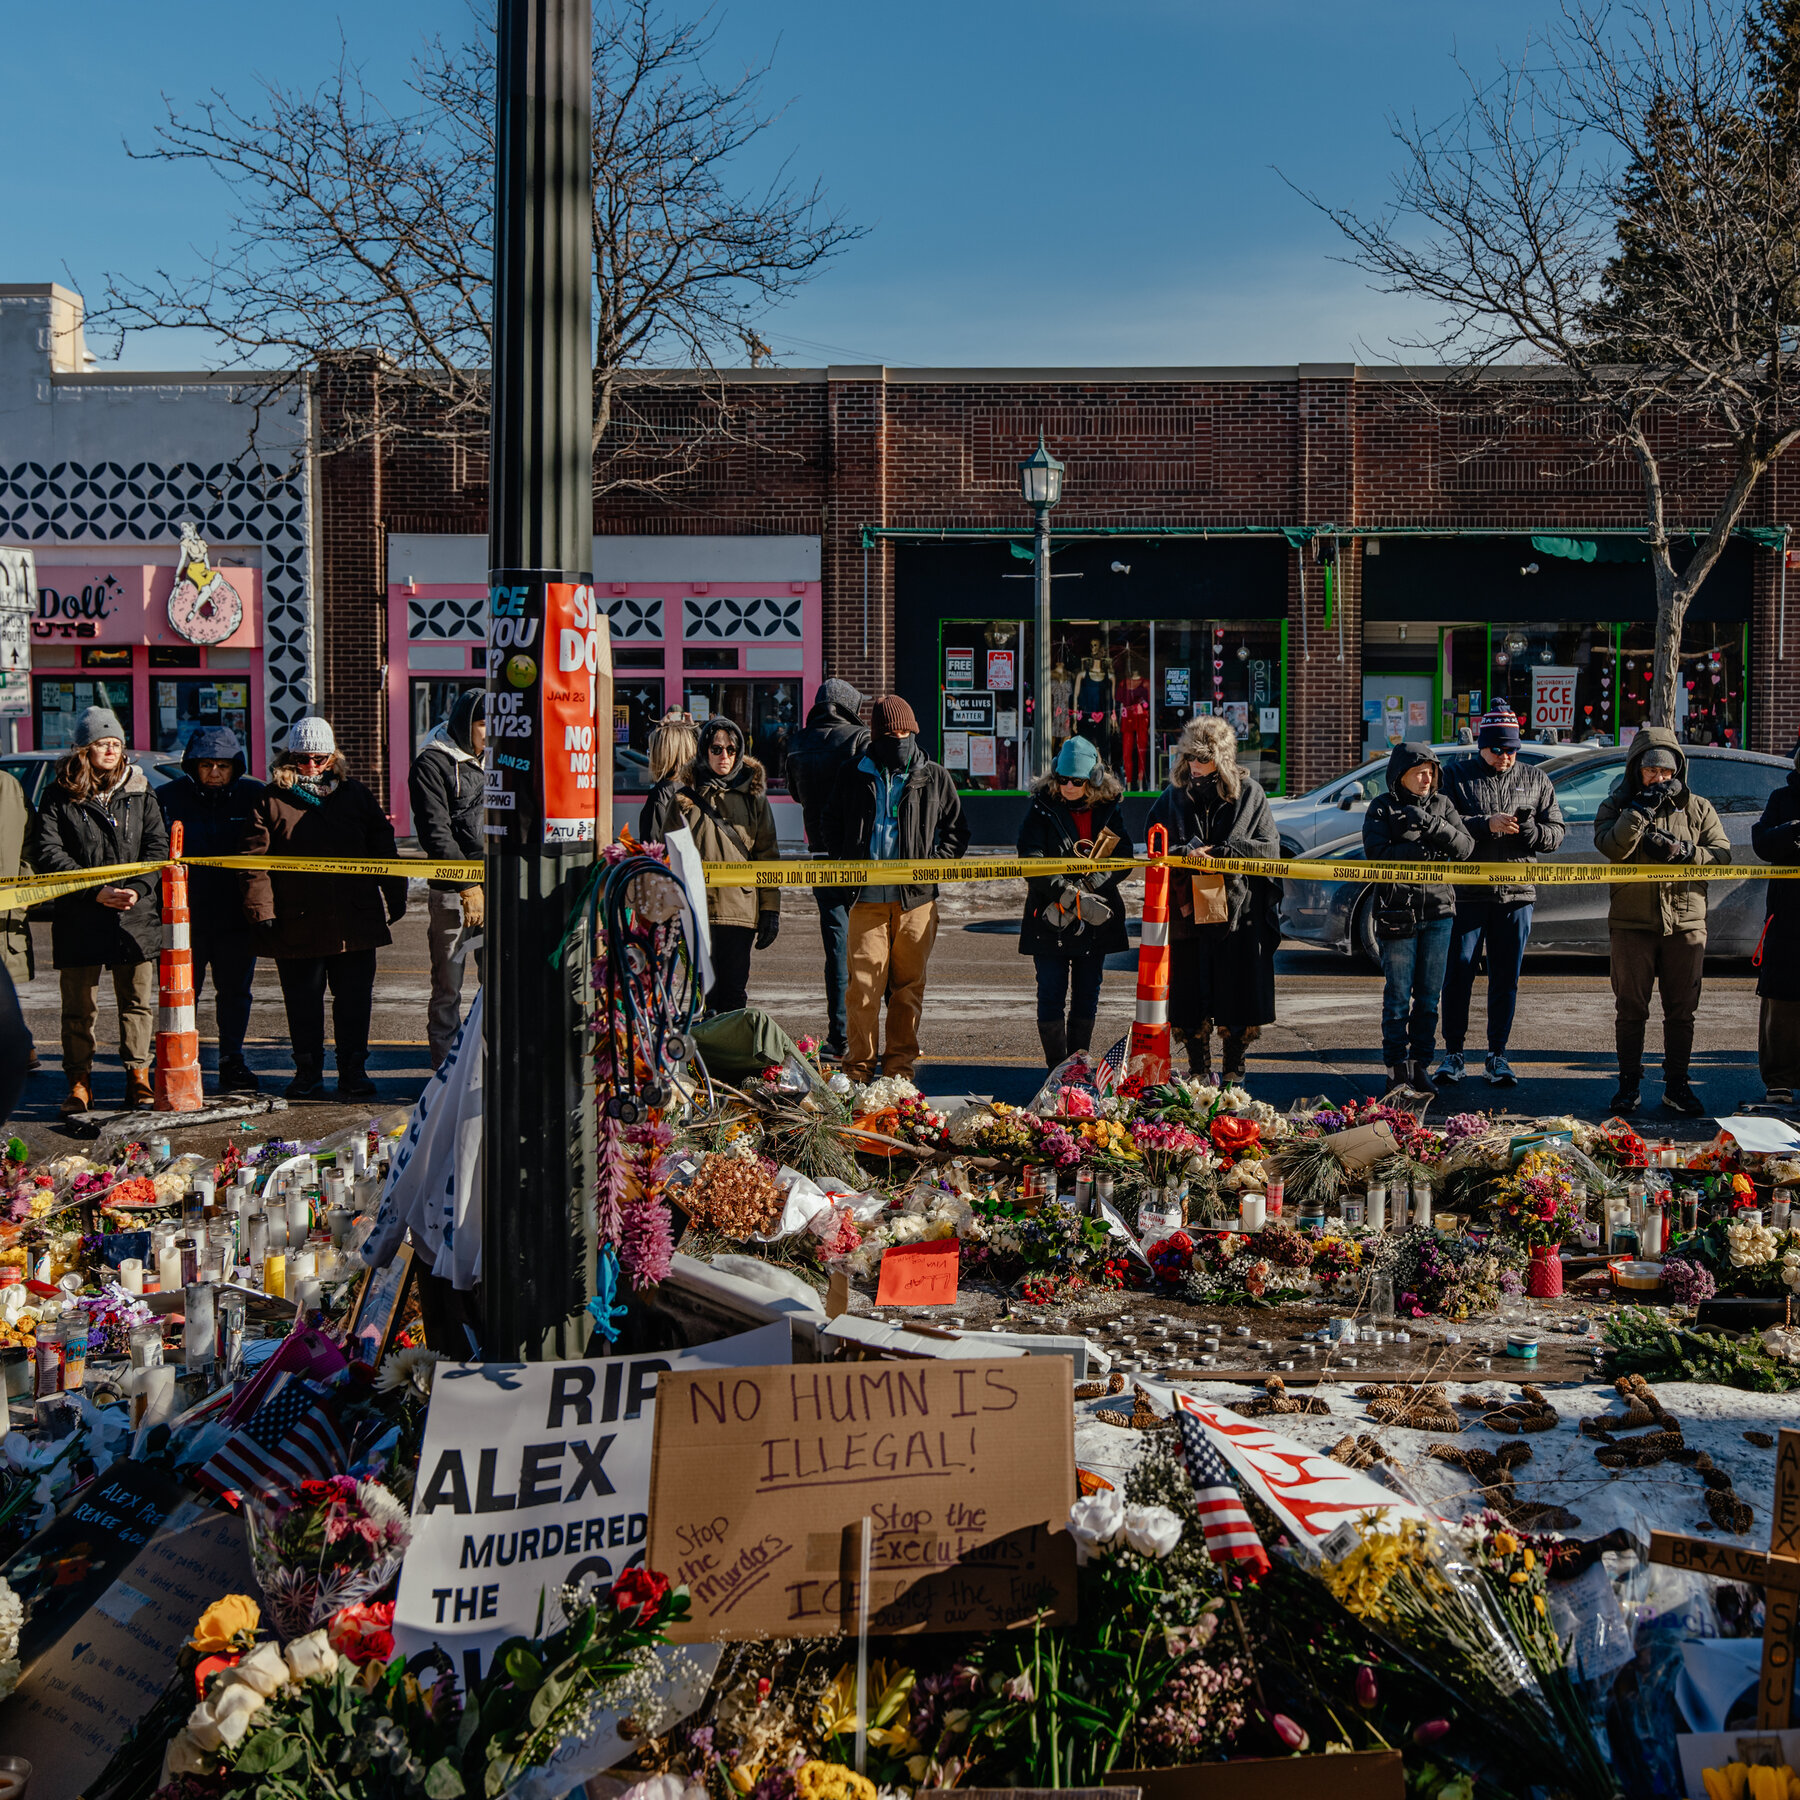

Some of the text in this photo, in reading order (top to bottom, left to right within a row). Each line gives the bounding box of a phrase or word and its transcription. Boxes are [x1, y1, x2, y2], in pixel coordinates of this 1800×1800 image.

[37, 585, 110, 620] Doll
[1, 630, 26, 643] ROUTE
[2, 617, 26, 627] TRUCK
[948, 661, 972, 671] FREE
[1253, 660, 1265, 703] OPEN
[1537, 687, 1571, 704] ICE
[547, 691, 585, 703] JAN 23
[946, 699, 991, 707] BLACK LIVES
[1536, 706, 1573, 724] OUT!
[564, 725, 592, 751] NO
[497, 752, 514, 767] JAN
[514, 755, 531, 771] 23
[570, 752, 590, 773] NO
[576, 774, 590, 788] NO
[551, 826, 574, 837] ATU
[434, 867, 461, 879] CROSS
[756, 870, 868, 884] POLICE LINE DO NOT CROSS
[912, 866, 1022, 881] POLICE LINE DO NOT CROSS
[1181, 856, 1289, 875] POLICE LINE DO NOT CROSS
[1333, 867, 1443, 881] POLICE LINE DO NOT CROSS
[546, 1358, 673, 1429] RIP
[690, 1368, 1018, 1424] NO HUMN IS
[760, 1426, 977, 1483] ILLEGAL!
[416, 1432, 617, 1515] ALEX
[100, 1480, 142, 1511] ALEX
[136, 1501, 168, 1528] PRE
[1776, 1440, 1799, 1551] ALEX
[74, 1501, 150, 1550] RENEE GOO
[870, 1502, 987, 1532] Stop the
[460, 1512, 648, 1569] MURDERED
[675, 1516, 729, 1557] Stop
[869, 1521, 1038, 1570] Executions!
[676, 1549, 721, 1587] the
[1672, 1540, 1767, 1579] BRAVE
[432, 1583, 500, 1624] THE
[785, 1581, 866, 1621] ICE
[894, 1580, 937, 1610] Get
[948, 1579, 993, 1606] the
[1765, 1603, 1791, 1728] SOU
